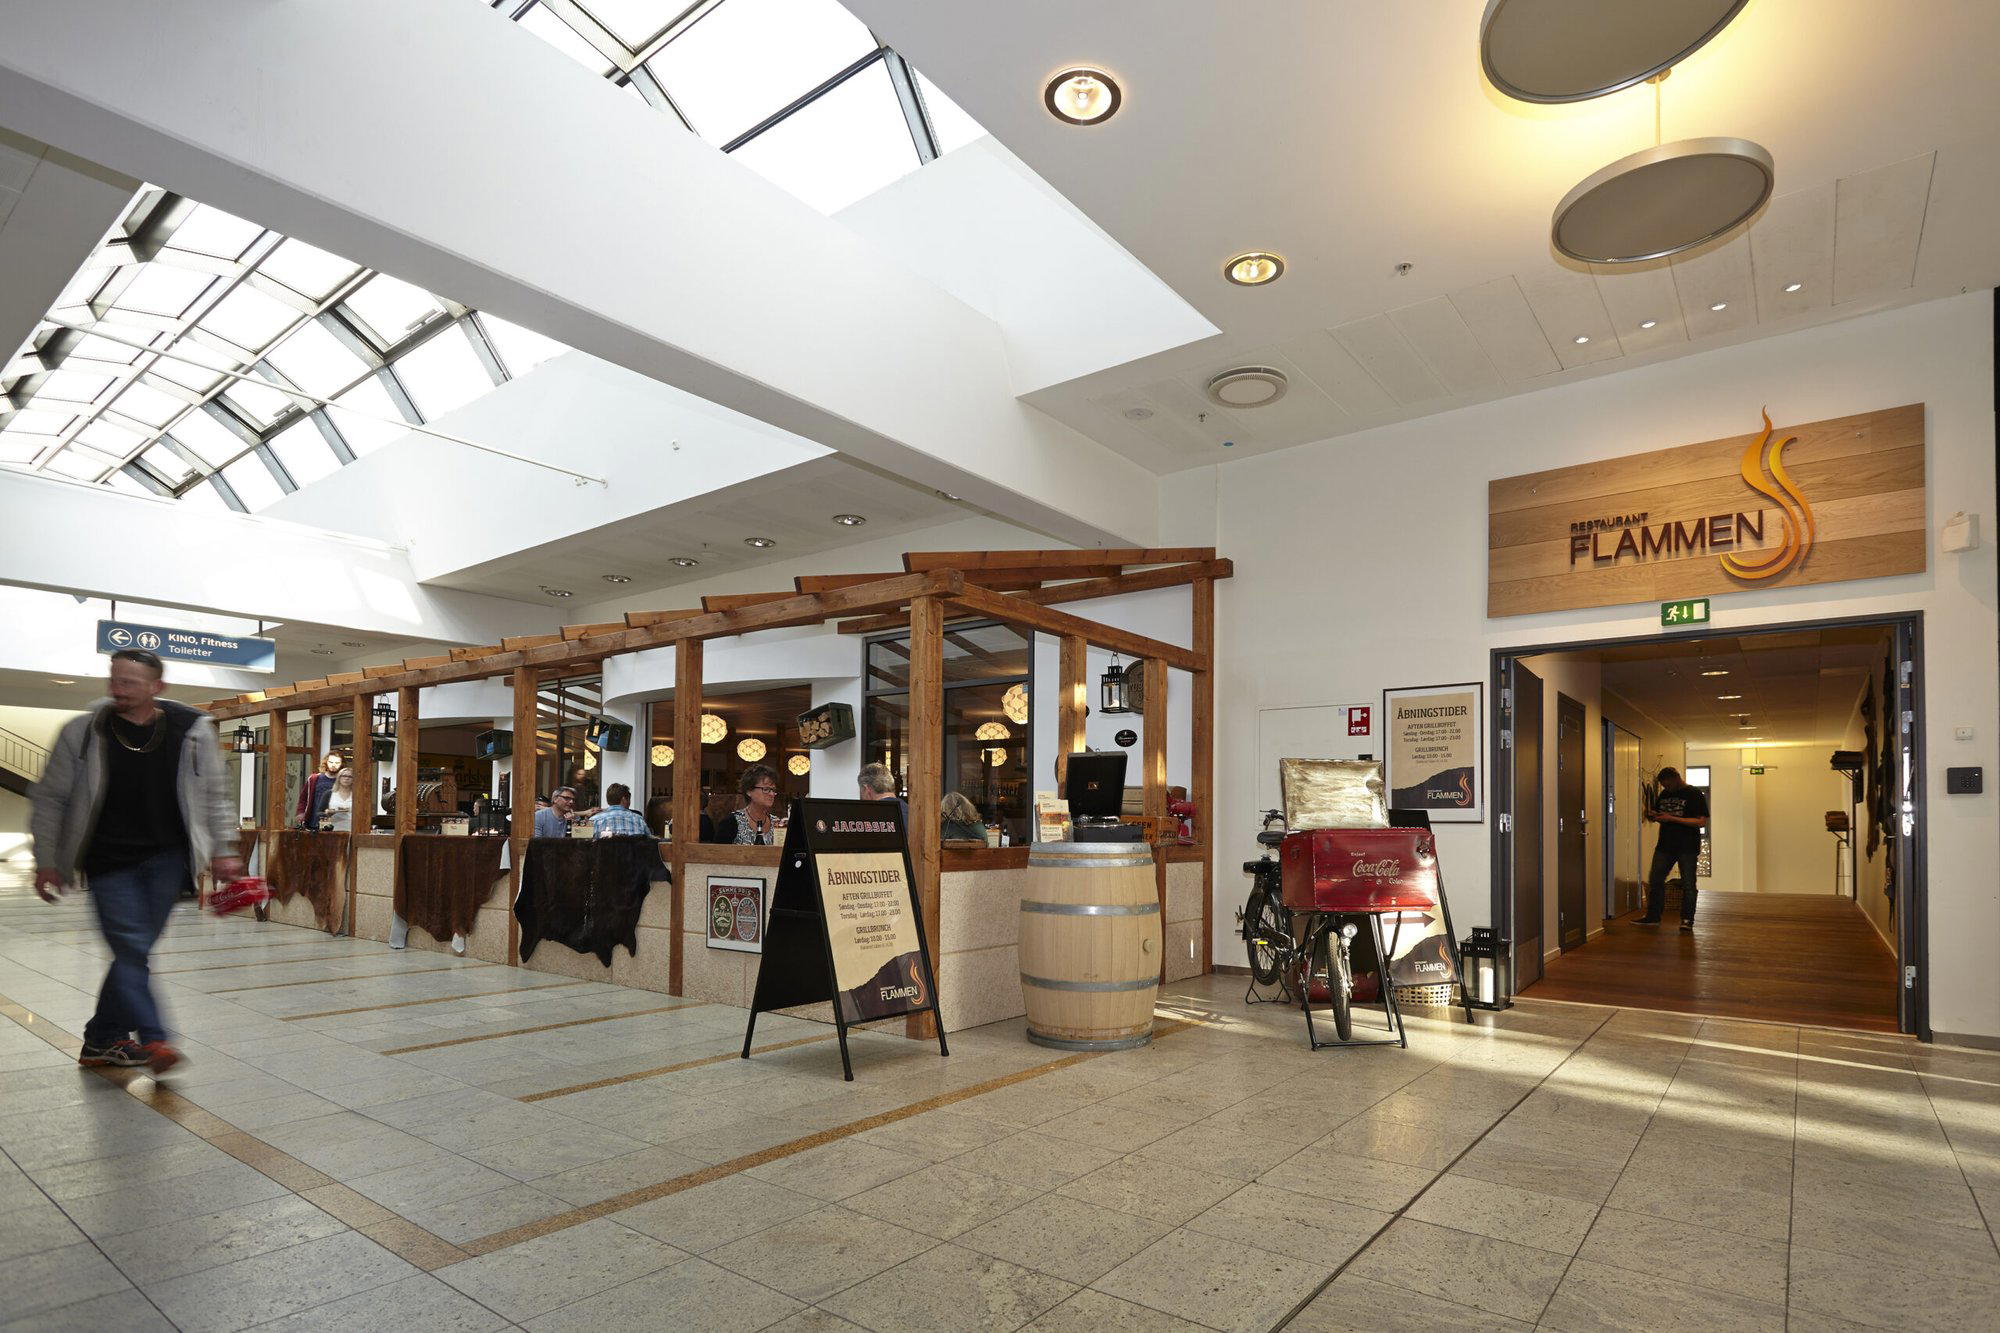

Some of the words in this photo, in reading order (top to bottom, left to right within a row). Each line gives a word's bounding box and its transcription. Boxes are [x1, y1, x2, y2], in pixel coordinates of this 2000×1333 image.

[1571, 512, 1649, 532] RESTAURANT
[1570, 510, 1763, 564] FLAMMEN
[168, 633, 198, 645] KINO,
[201, 637, 238, 649] Fitness
[168, 645, 213, 657] Toiletter
[1397, 705, 1467, 719] ÅBNINGSTIDER
[1427, 791, 1463, 800] FLAMMEN
[832, 820, 896, 832] JACOBSEN
[828, 868, 901, 885] ÅBNINGSTIDER
[842, 892, 859, 900] AFTEN
[1415, 962, 1446, 973] FLAMMEN
[881, 986, 918, 1000] FLAMMEN
